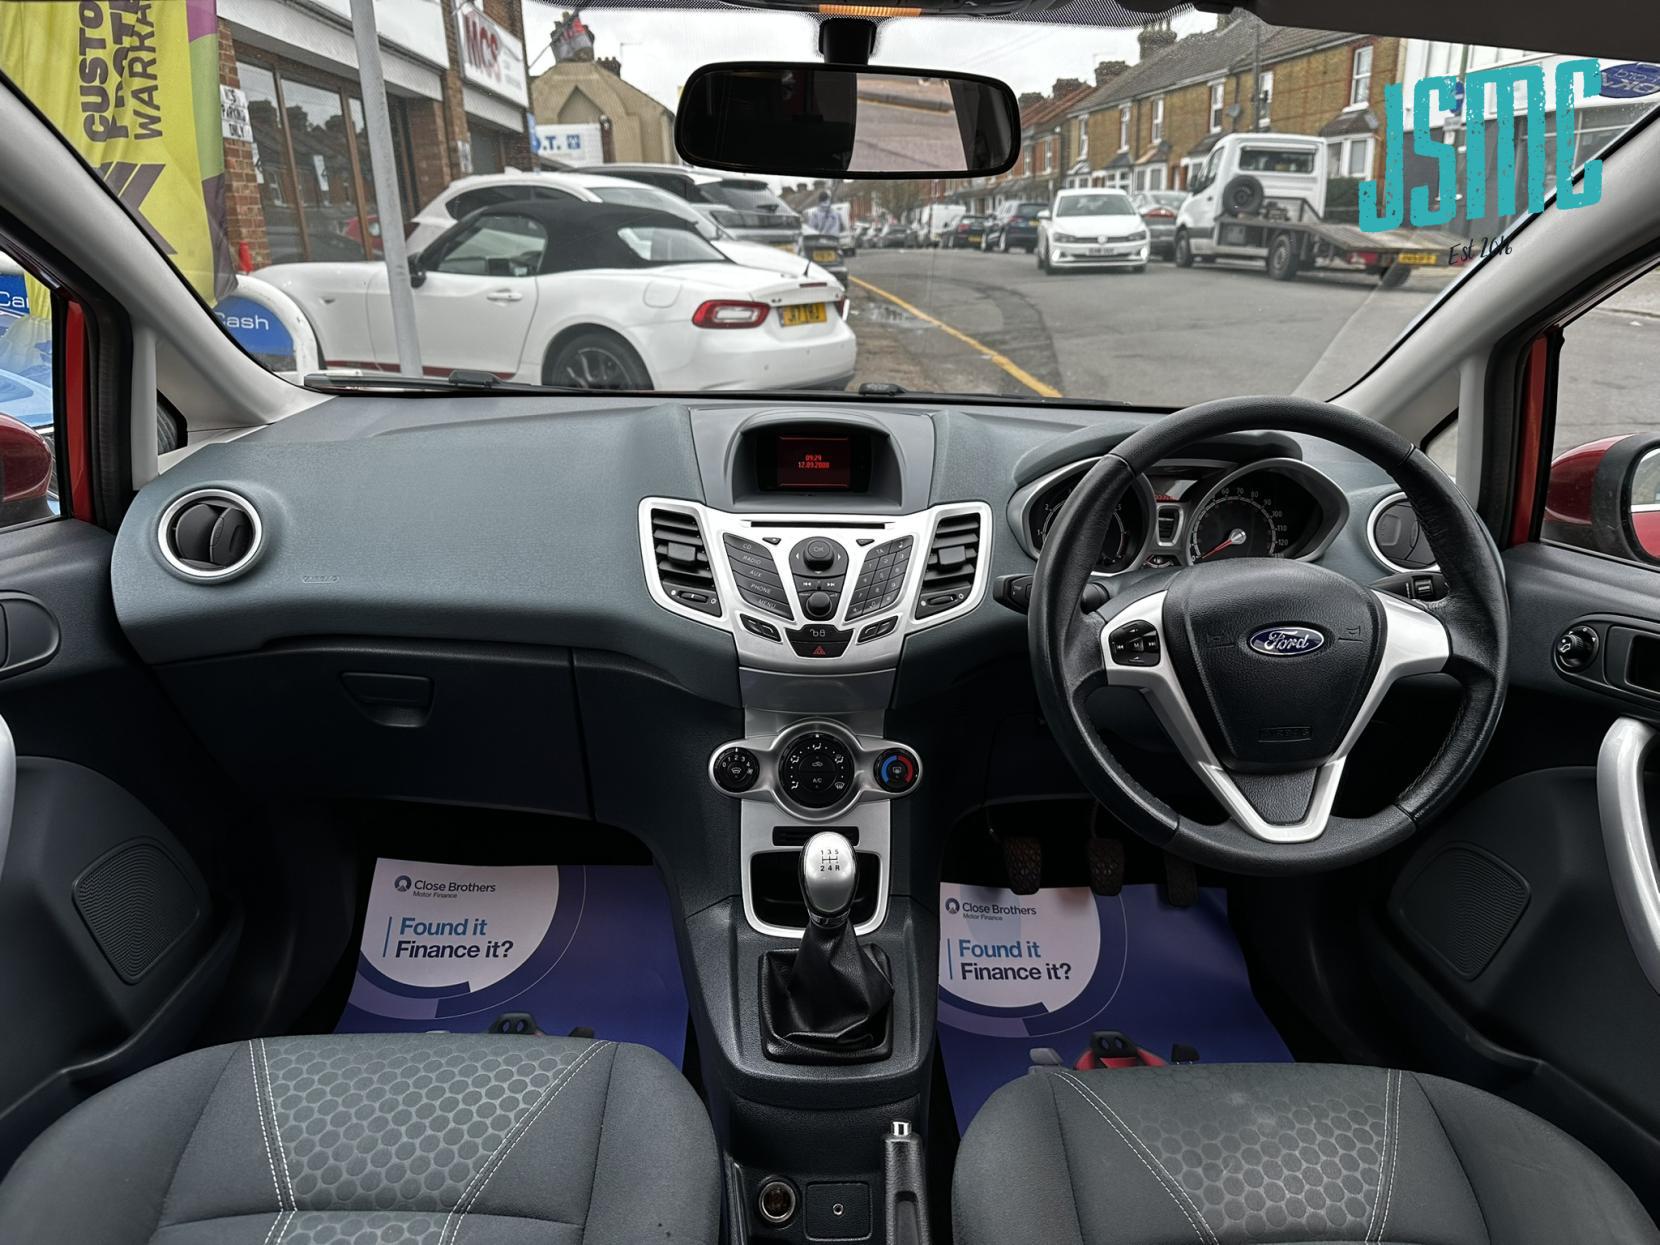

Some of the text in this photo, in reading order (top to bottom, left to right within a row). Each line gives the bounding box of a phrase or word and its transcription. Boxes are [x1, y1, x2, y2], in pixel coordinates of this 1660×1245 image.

[1264, 630, 1310, 650] Ford
[412, 890, 432, 898] Motor
[414, 879, 496, 893] Close Brothers
[962, 902, 1037, 916] Close Brothers
[400, 917, 488, 936] Found it
[395, 940, 514, 959] Finance it?
[958, 939, 1042, 958] Found it
[960, 962, 1072, 981] Finance it?
